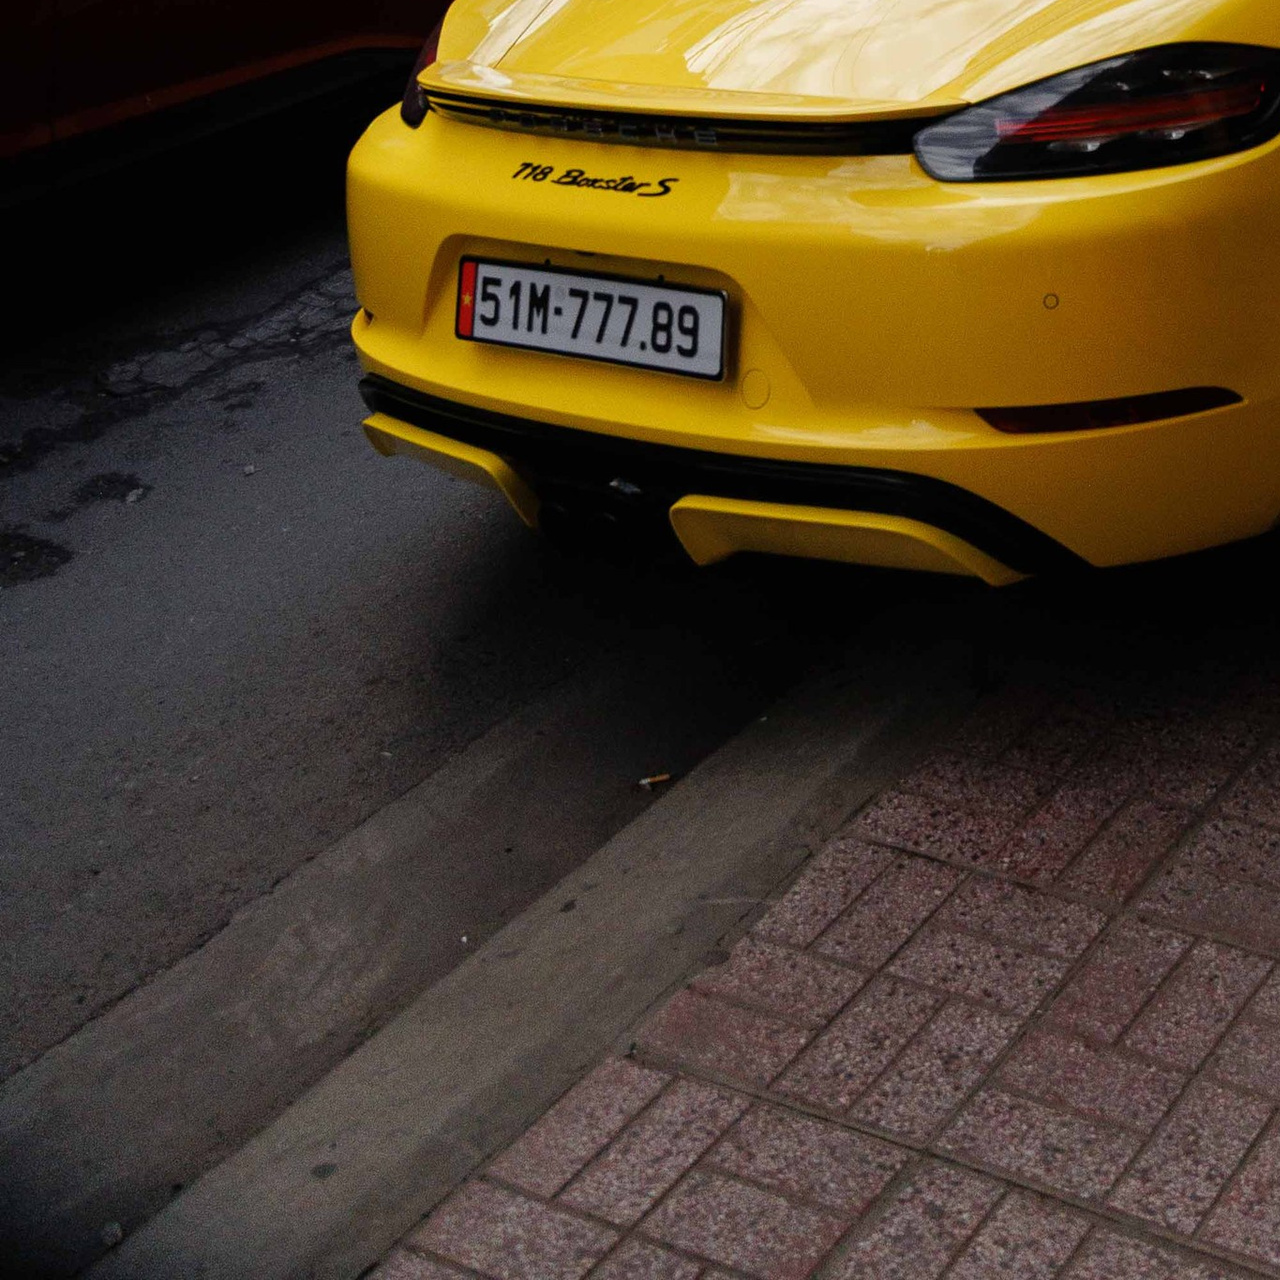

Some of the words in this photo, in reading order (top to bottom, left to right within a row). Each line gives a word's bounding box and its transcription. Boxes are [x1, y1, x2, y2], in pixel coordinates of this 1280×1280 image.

[512, 162, 553, 181] 718
[551, 169, 650, 193] Boxster
[637, 178, 679, 197] S
